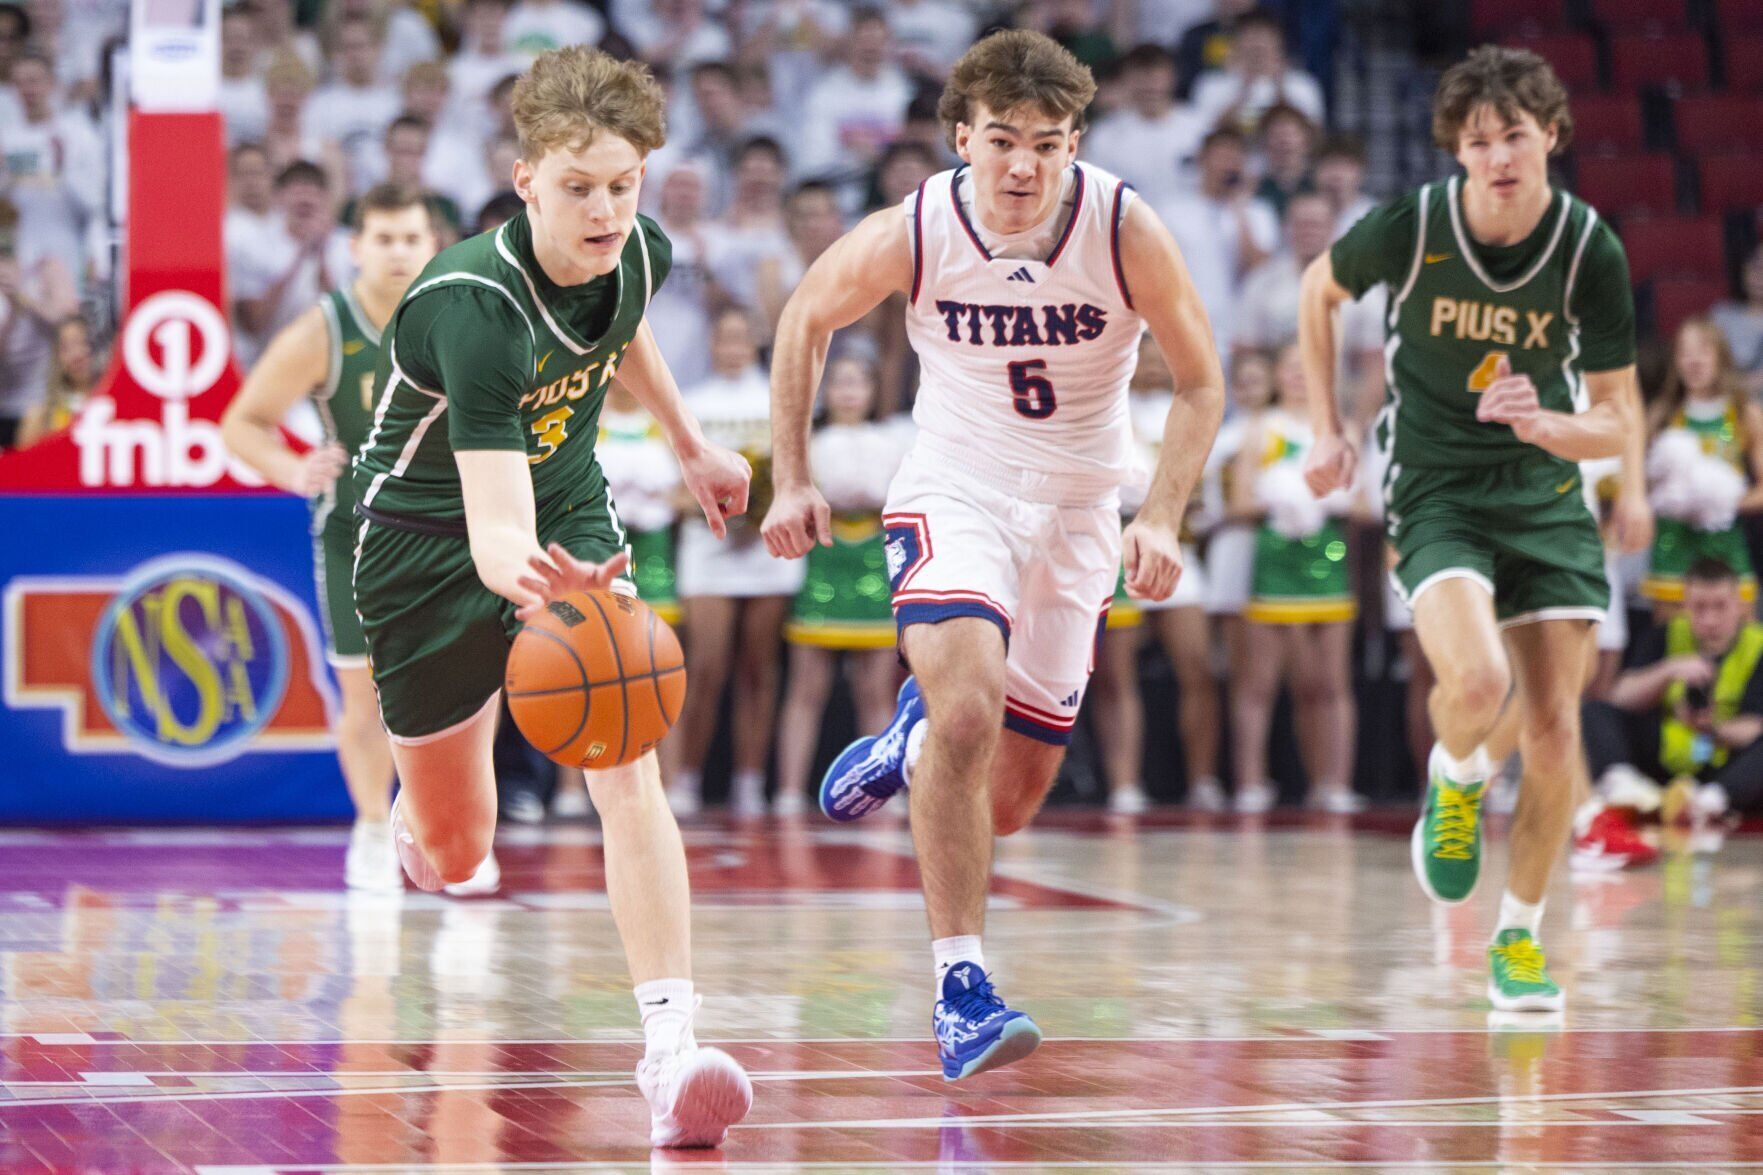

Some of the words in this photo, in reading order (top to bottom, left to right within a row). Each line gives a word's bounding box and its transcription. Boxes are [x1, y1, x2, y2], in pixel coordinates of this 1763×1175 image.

[936, 300, 1107, 346] TITANS
[1430, 296, 1518, 345] PIUS
[1522, 311, 1554, 350] X
[1007, 359, 1057, 419] 5
[71, 396, 267, 487] fnb
[527, 405, 575, 464] 3
